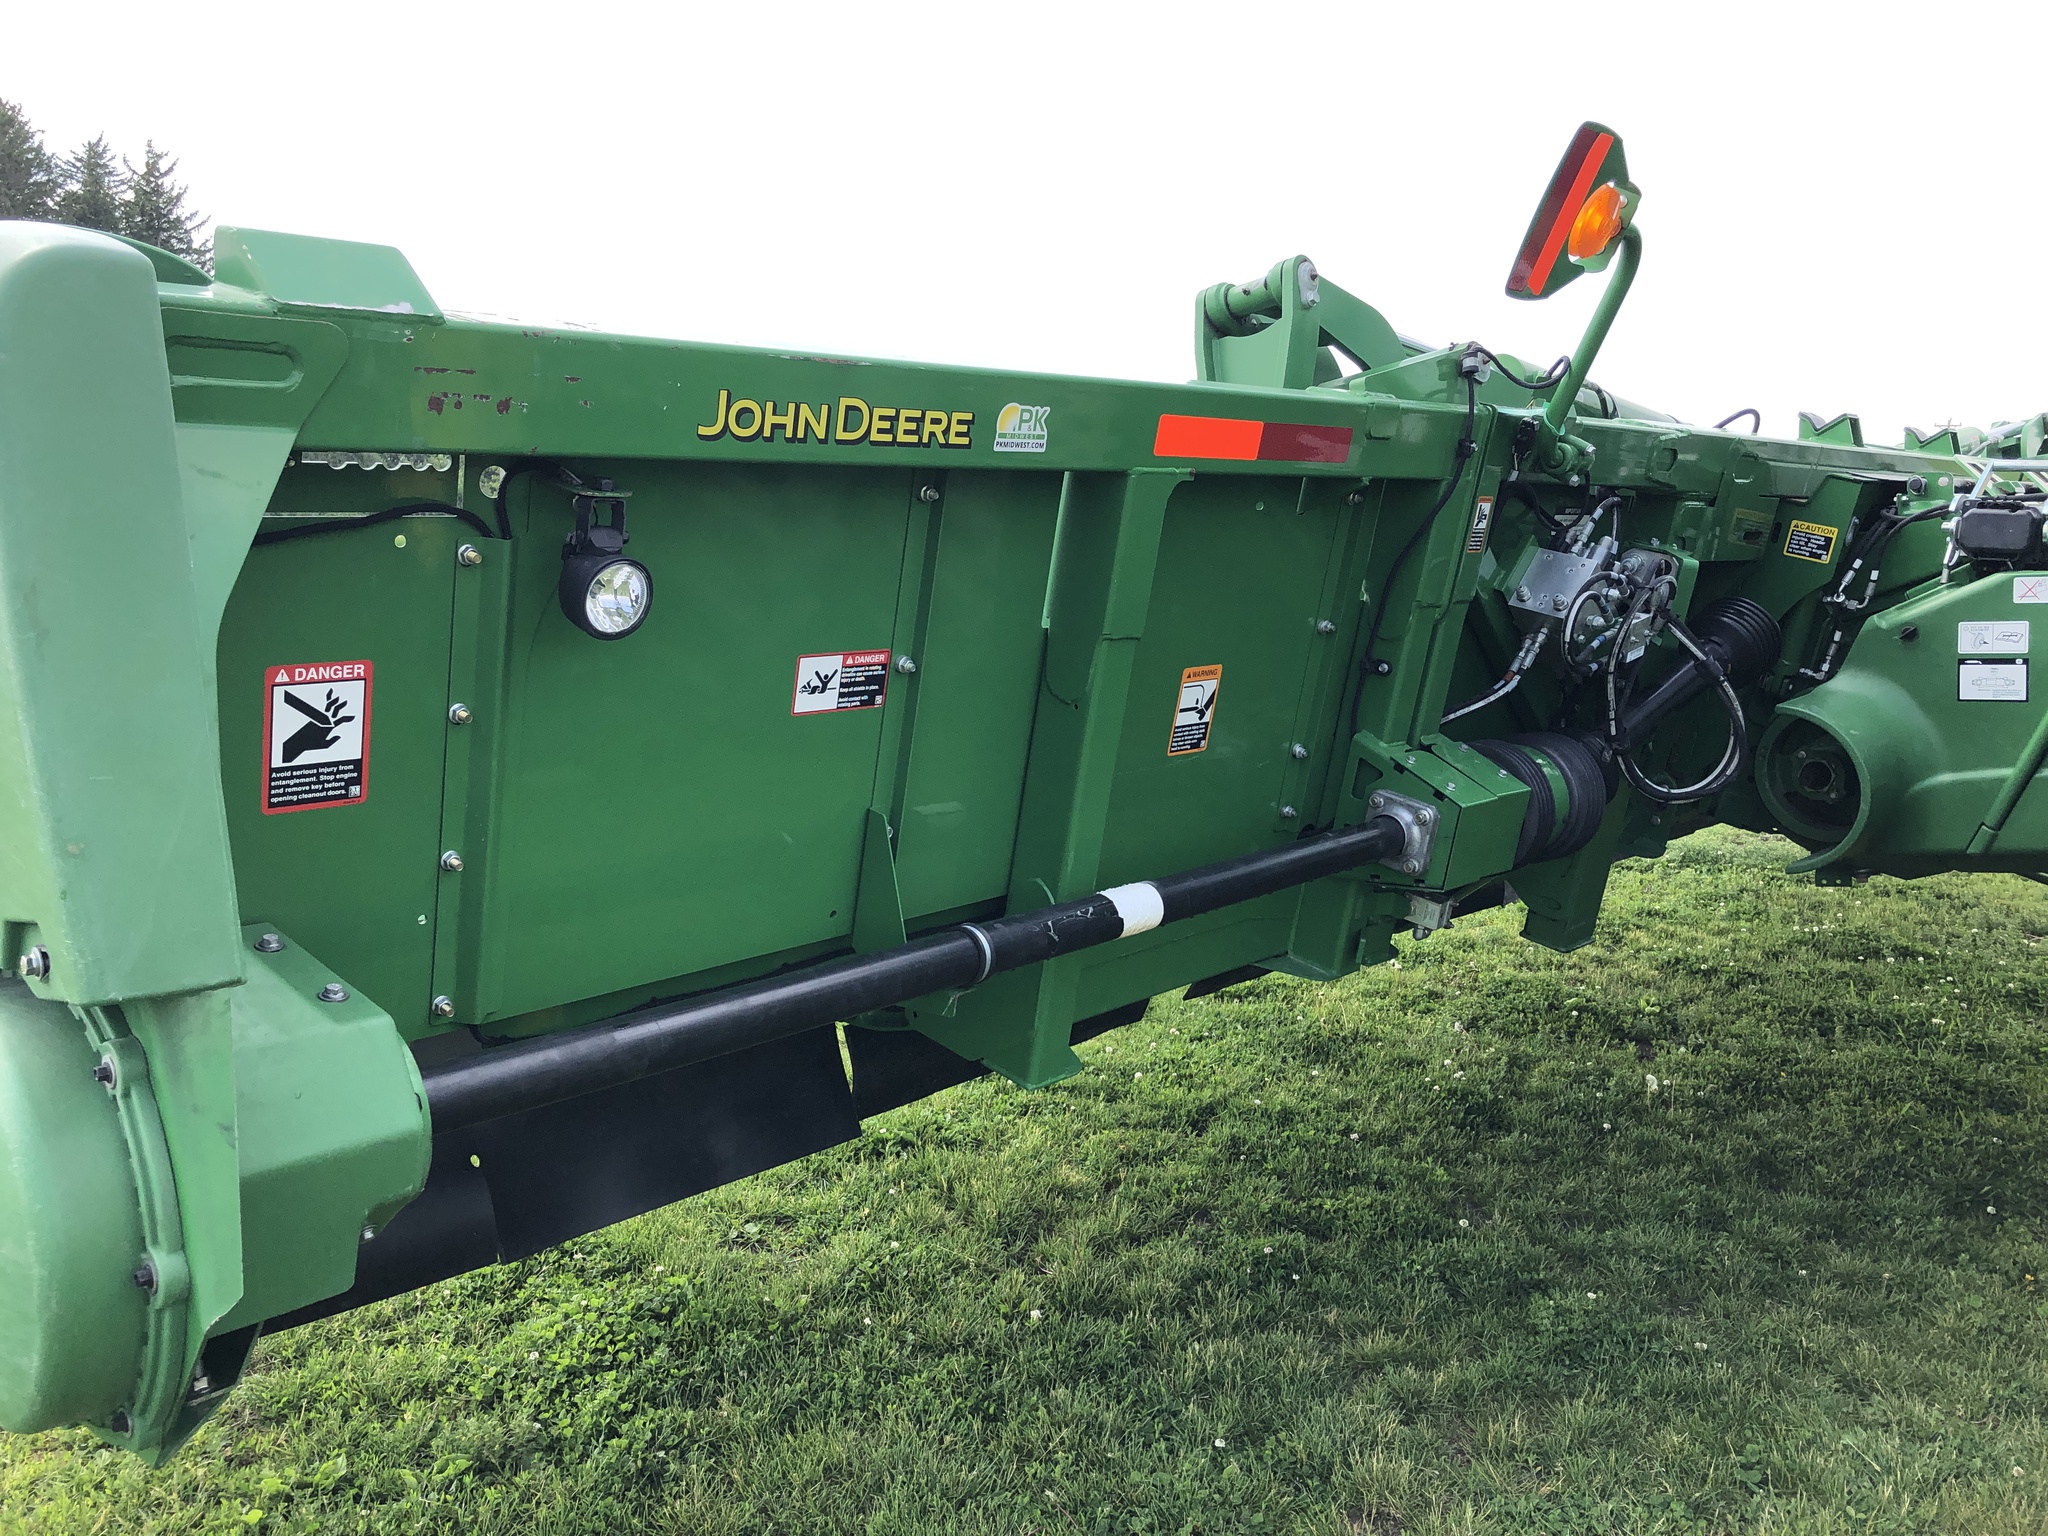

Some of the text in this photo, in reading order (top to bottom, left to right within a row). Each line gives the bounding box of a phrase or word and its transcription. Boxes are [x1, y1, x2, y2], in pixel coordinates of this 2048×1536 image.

[697, 389, 974, 448] JOHN DEERE
[995, 441, 1045, 449] PKMIDWEST.COM
[1800, 523, 1835, 535] CAUTION
[855, 655, 884, 663] DANGER
[295, 664, 364, 681] DANGER
[1192, 669, 1217, 677] WARNING
[271, 777, 317, 786] entanglement.
[271, 795, 297, 803] opening
[298, 791, 326, 799] cleanout
